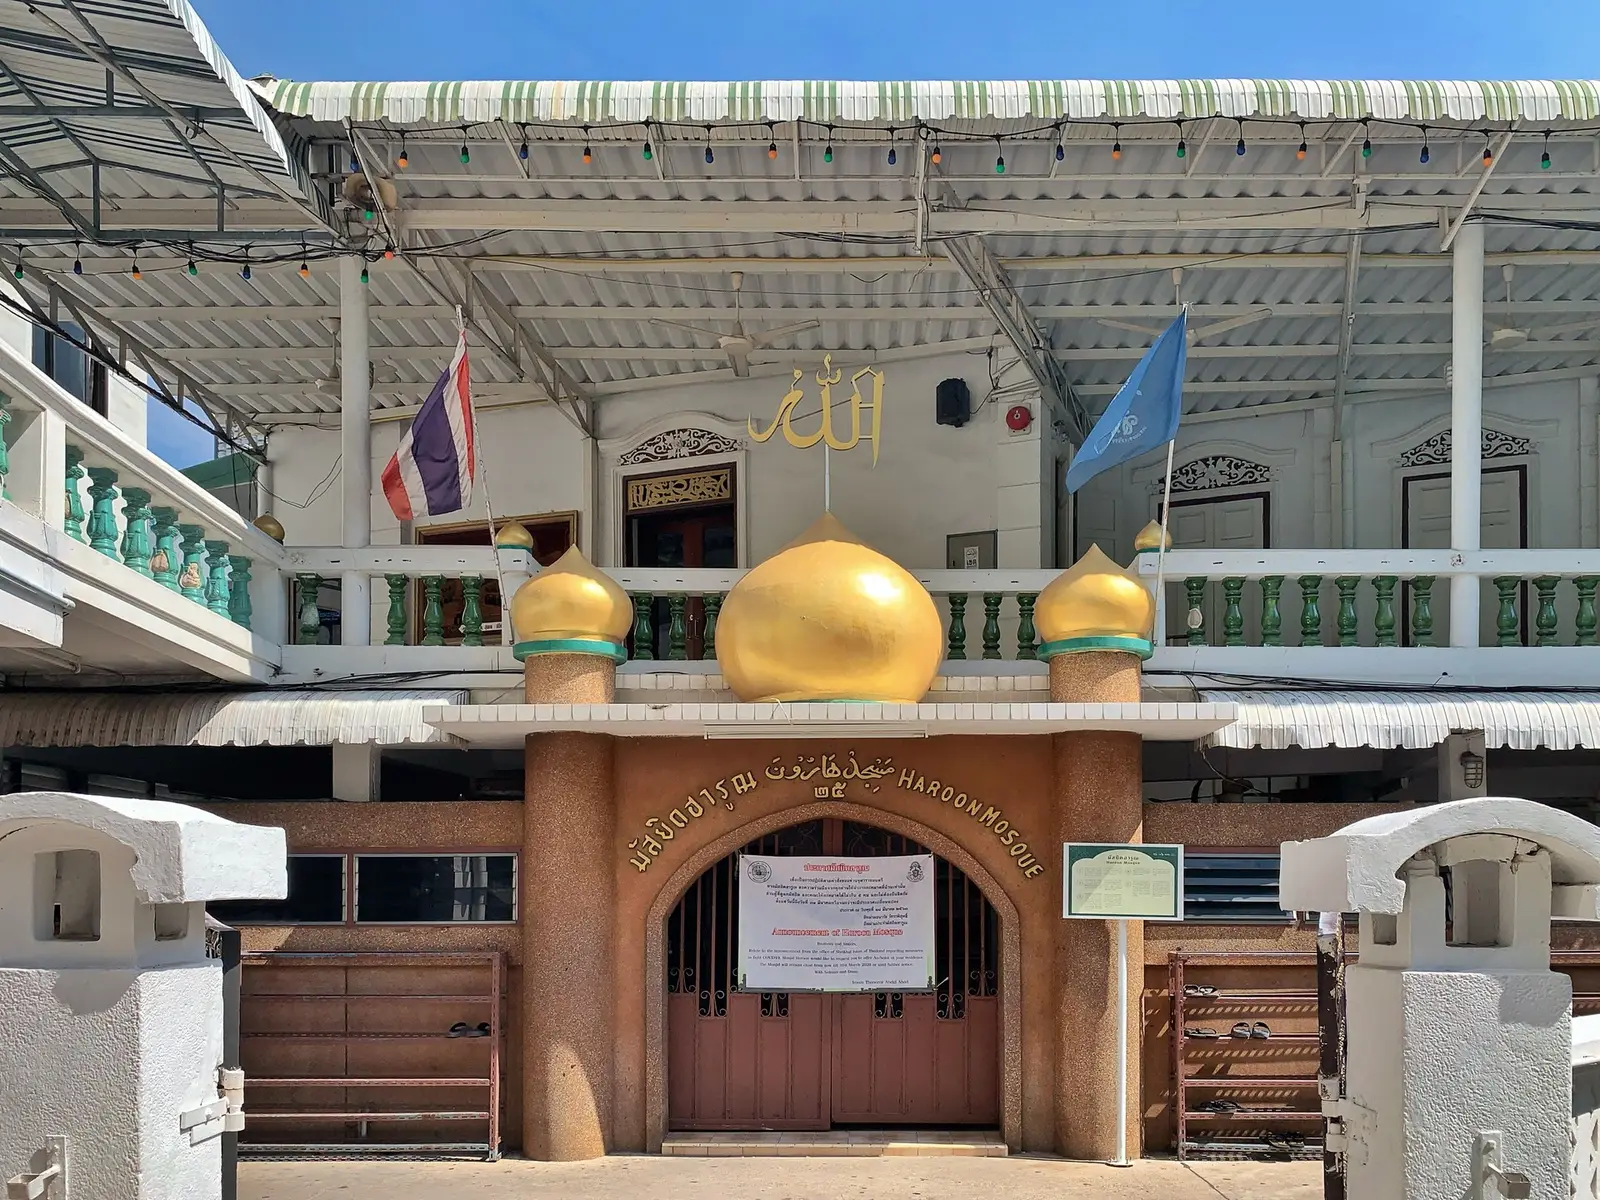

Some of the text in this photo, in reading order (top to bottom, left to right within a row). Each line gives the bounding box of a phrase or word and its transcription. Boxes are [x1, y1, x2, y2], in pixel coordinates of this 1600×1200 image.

[814, 781, 847, 799] ๒๕
[628, 770, 758, 873] มัสยิดฮารูณ
[897, 767, 1045, 879] HAROON MOSQUE
[771, 927, 830, 937] Announcement
[831, 928, 840, 936] of
